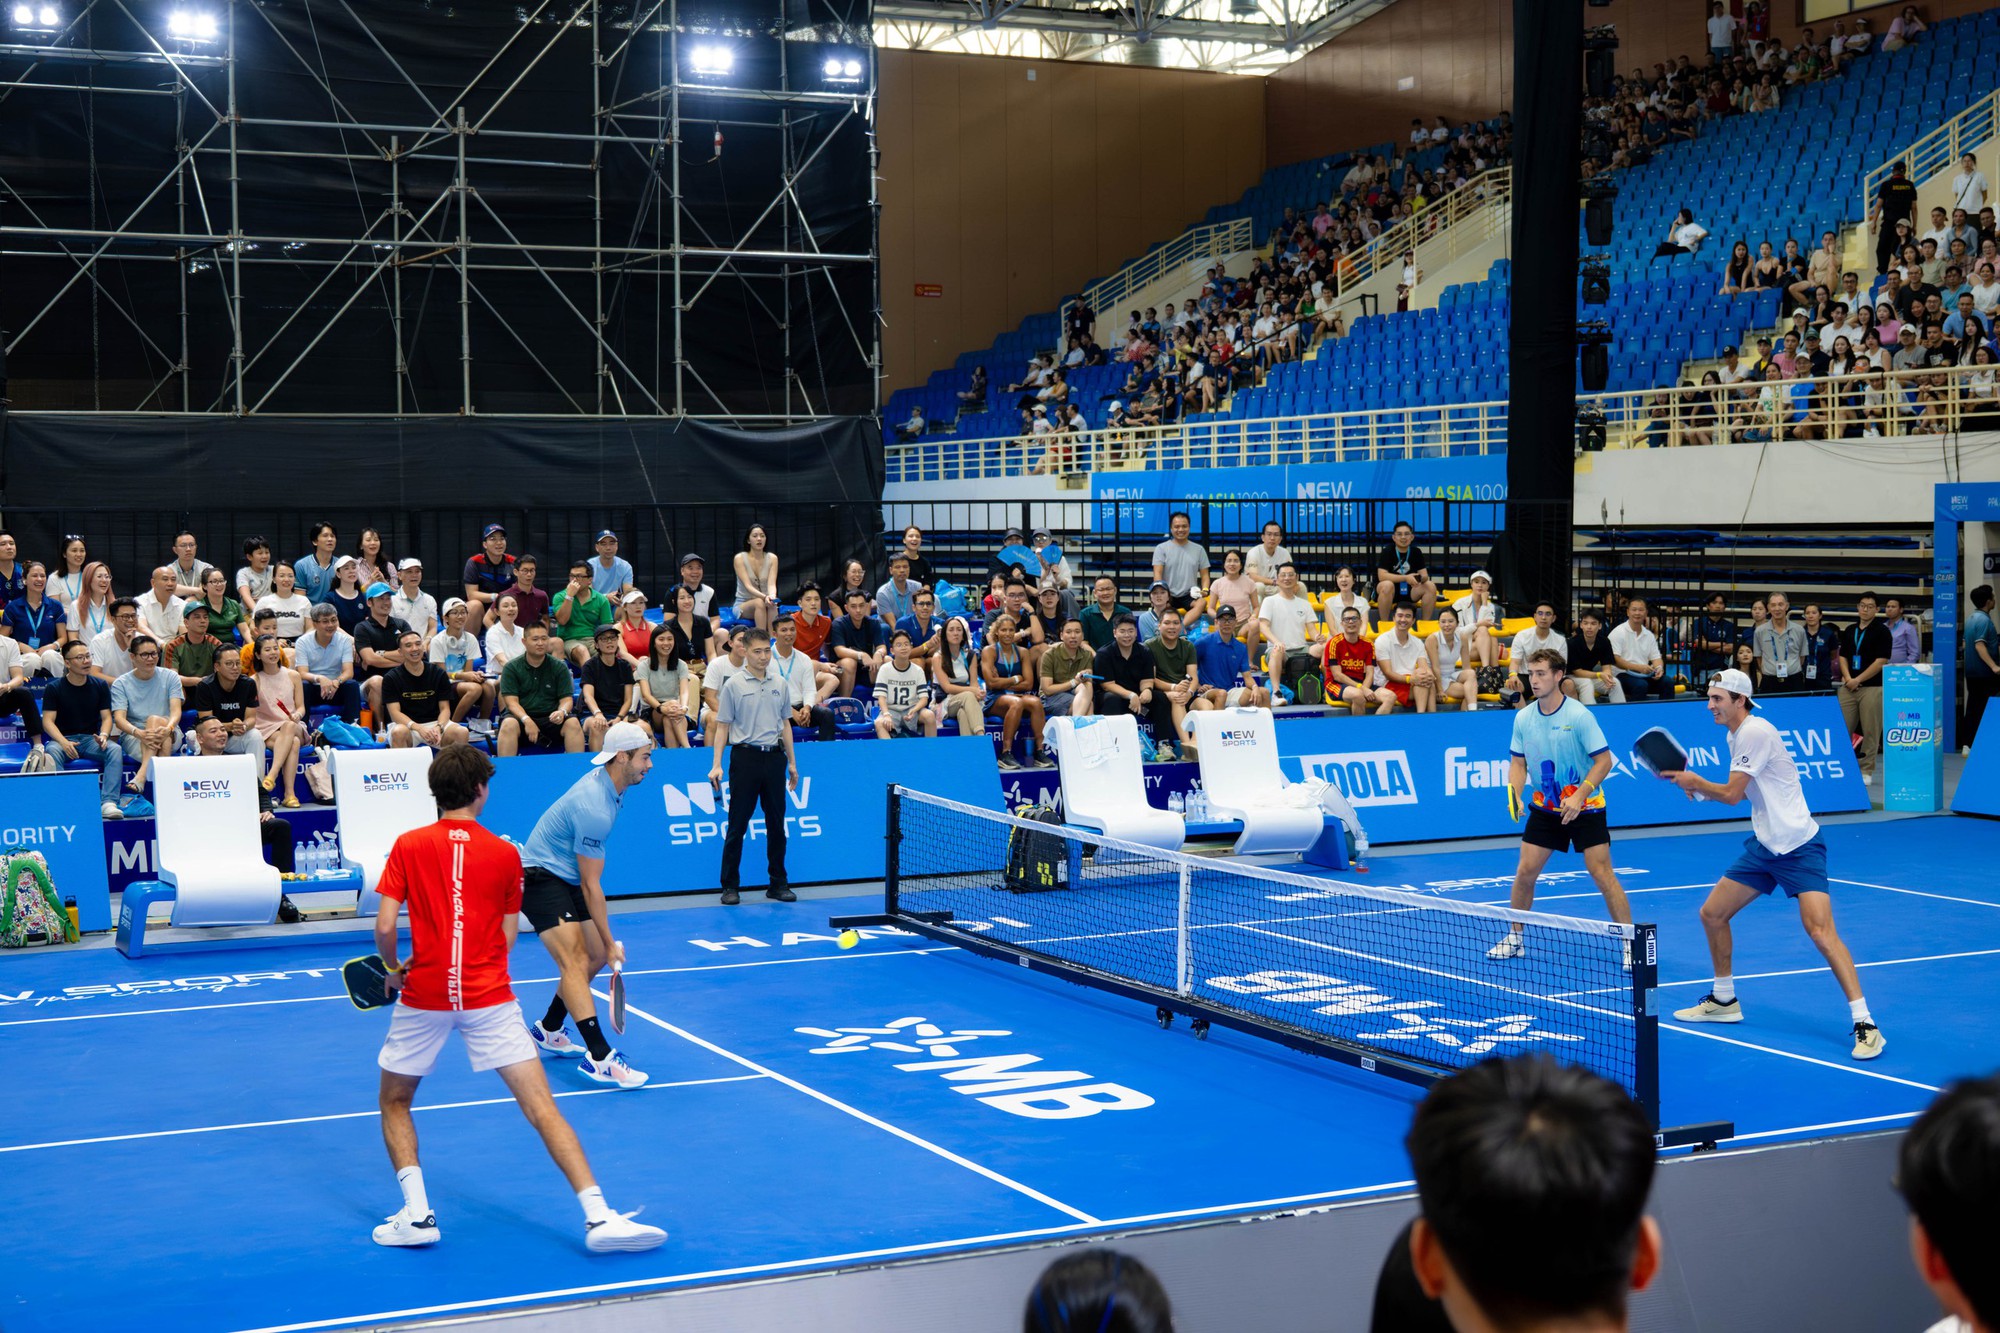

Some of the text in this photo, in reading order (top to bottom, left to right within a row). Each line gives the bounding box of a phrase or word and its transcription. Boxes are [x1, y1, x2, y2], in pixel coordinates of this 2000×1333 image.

[1297, 481, 1352, 499] NEW
[1435, 483, 1508, 501] ASIA100
[893, 687, 910, 705] 12
[1221, 730, 1255, 740] NEW
[1777, 729, 1831, 757] EW
[1887, 729, 1931, 744] CUP
[183, 780, 229, 791] NEW
[363, 772, 408, 784] NEW
[1313, 759, 1405, 799] JOOLA
[184, 791, 231, 799] SPORTS
[364, 783, 410, 792] SPORTS
[1647, 941, 1655, 964] JOOLA
[447, 967, 458, 1003] STRIA
[892, 1053, 1156, 1120] MB
